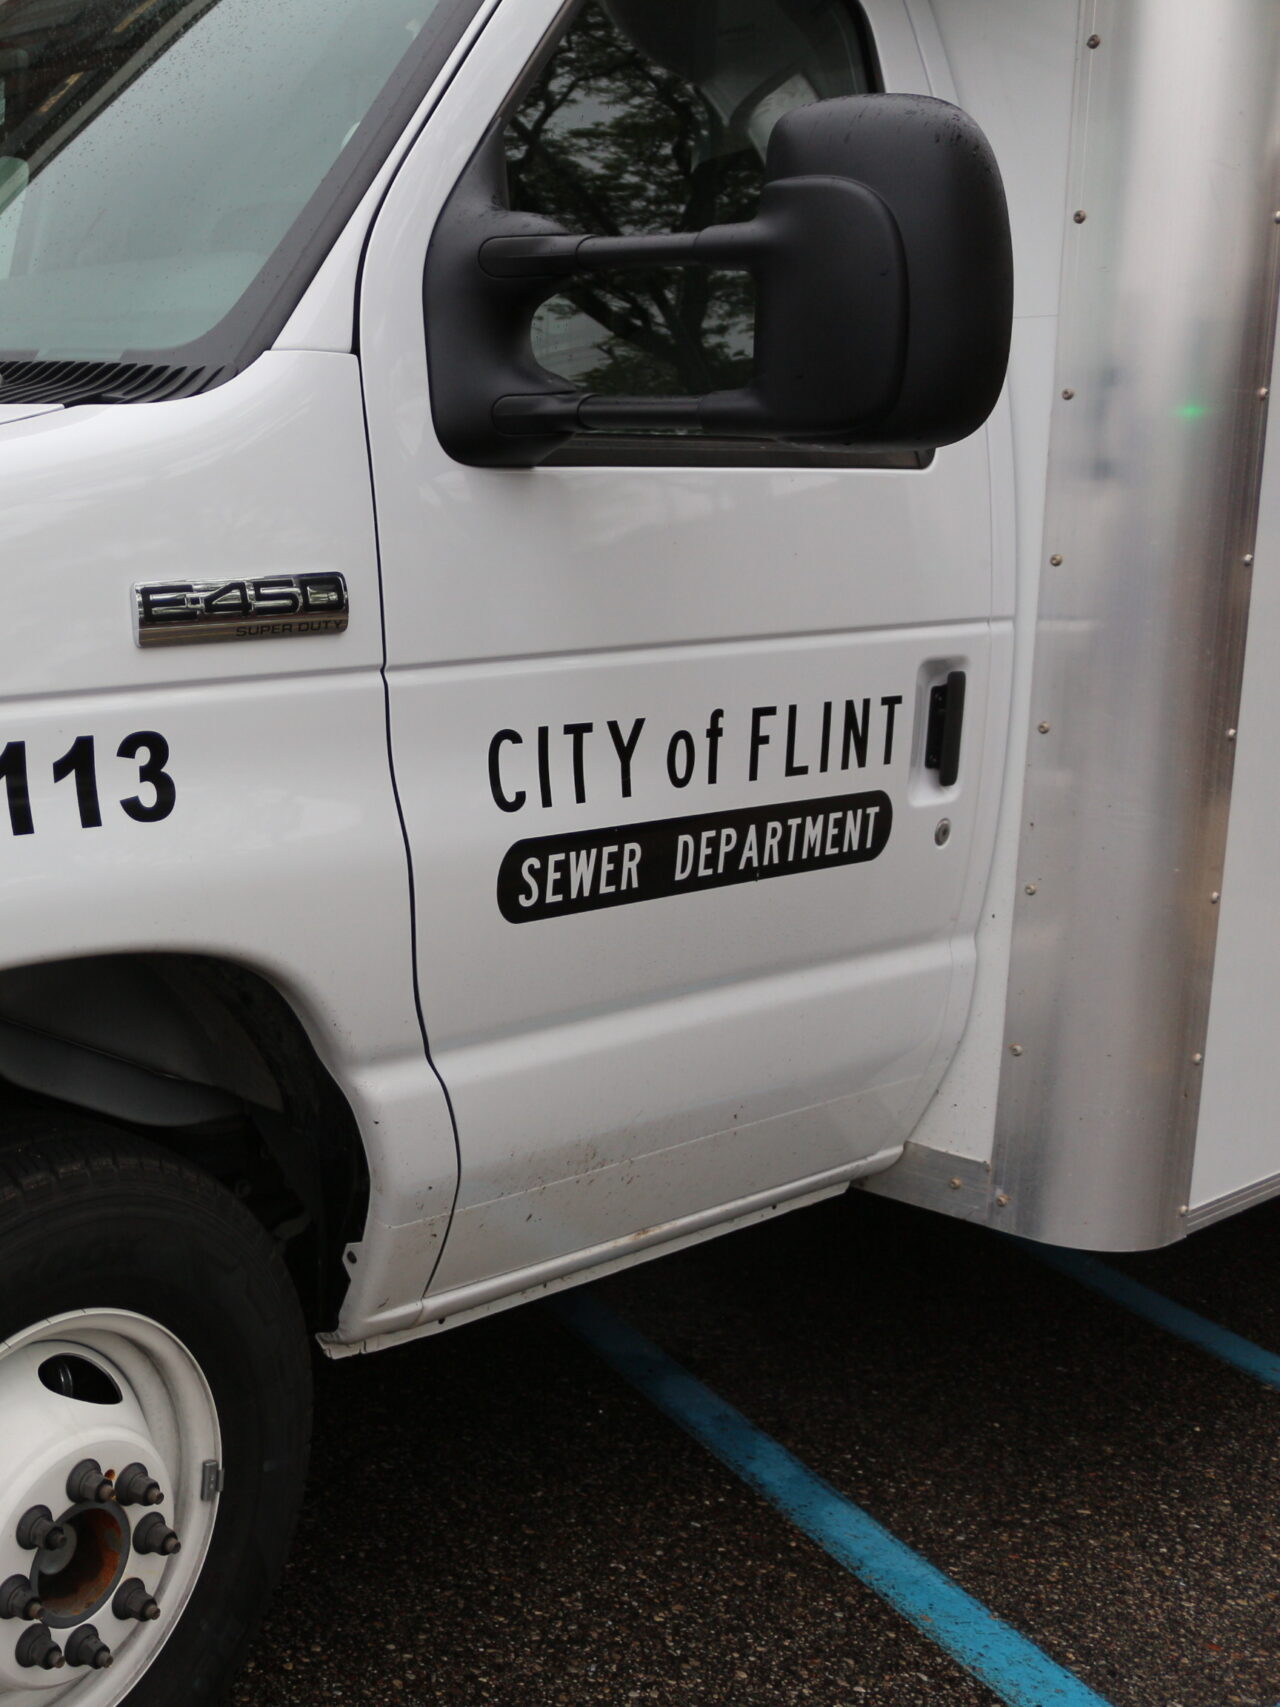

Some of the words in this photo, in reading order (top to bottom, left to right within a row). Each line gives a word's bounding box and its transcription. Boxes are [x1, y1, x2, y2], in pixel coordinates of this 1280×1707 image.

[138, 576, 346, 622] E-450
[235, 622, 293, 637] SUPER
[297, 619, 344, 633] DUTY
[488, 717, 646, 813] CITY
[666, 708, 725, 789] of
[748, 695, 903, 782] FLINT
[518, 841, 642, 908] SEWER
[674, 805, 881, 882] DEPARTMENT
